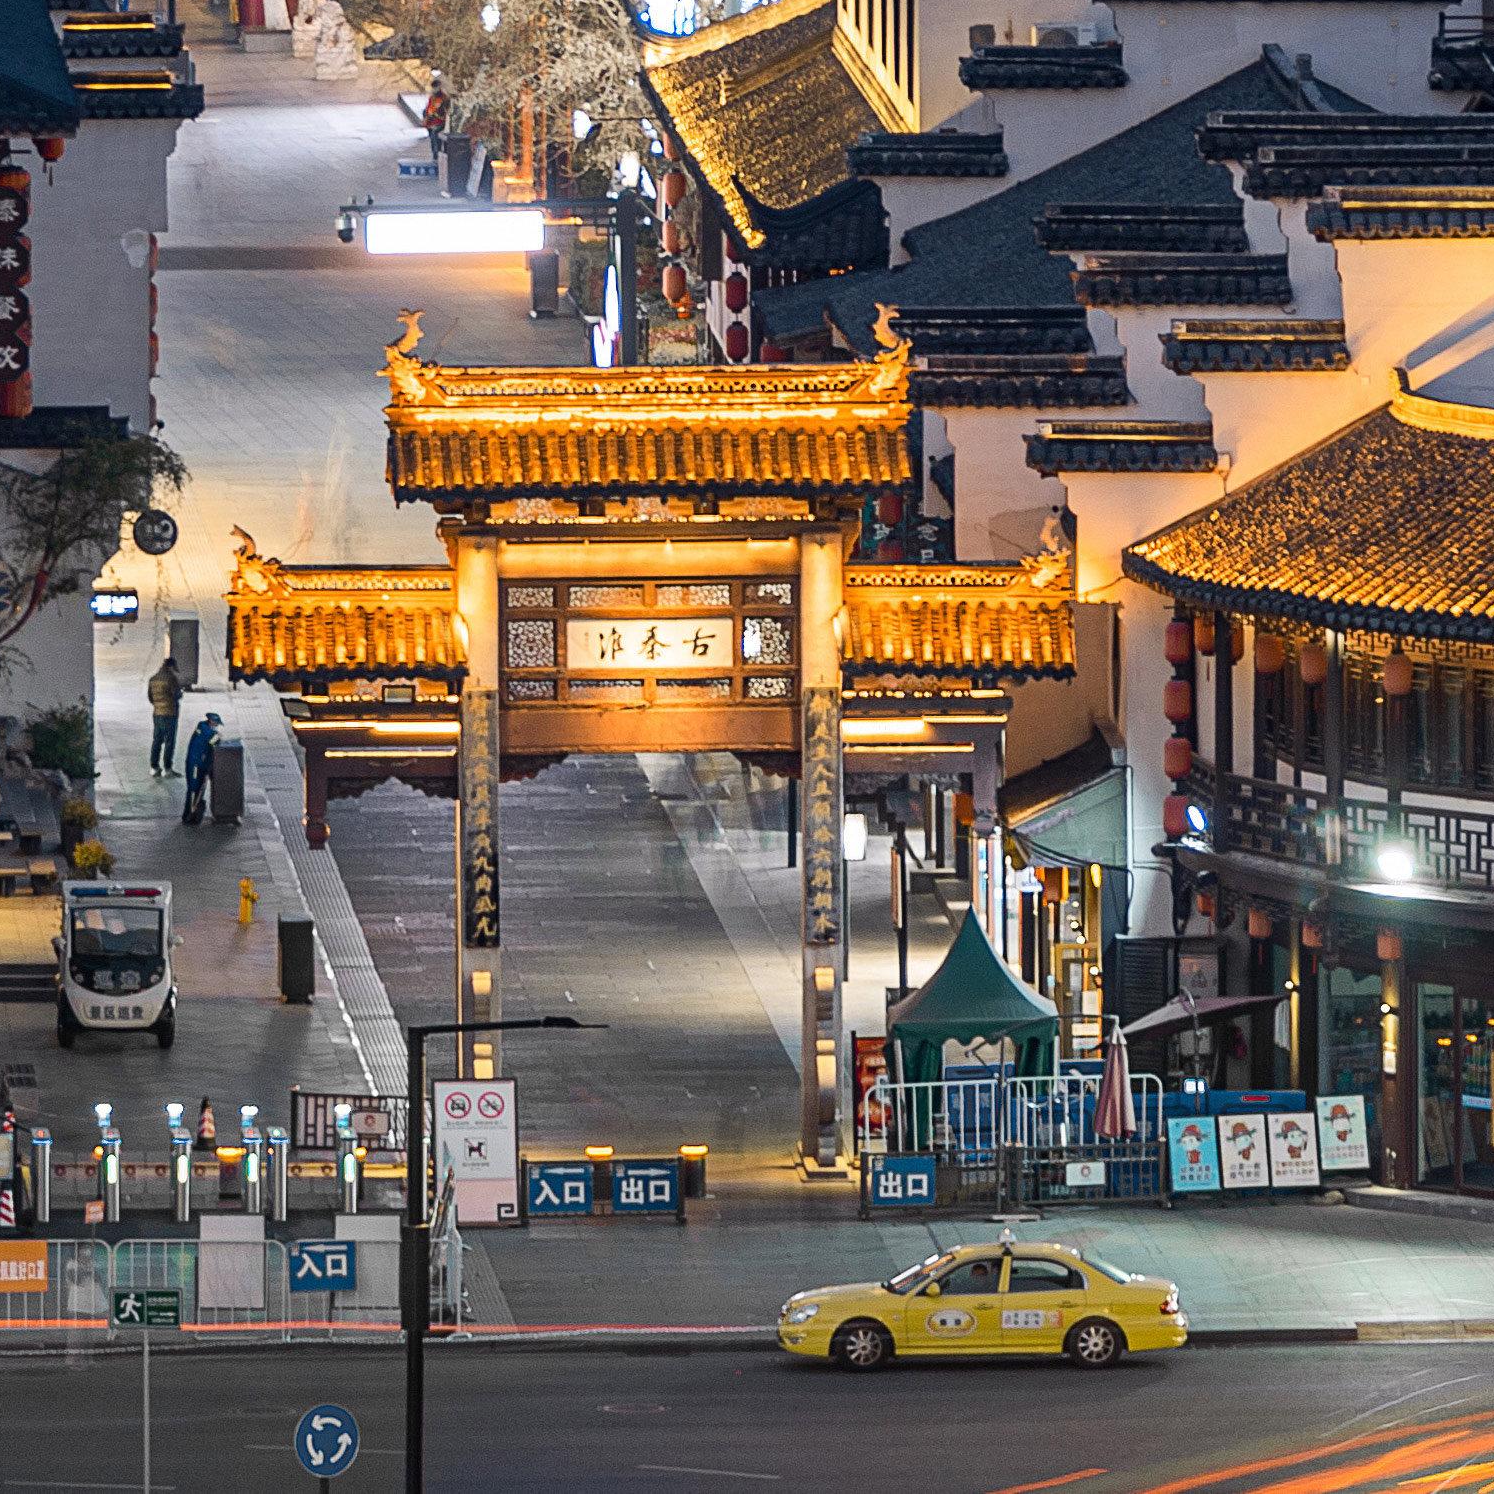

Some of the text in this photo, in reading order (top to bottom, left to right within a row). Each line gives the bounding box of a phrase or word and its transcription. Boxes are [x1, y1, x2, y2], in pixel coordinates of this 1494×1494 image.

[598, 625, 716, 660] 古秦淮
[534, 1180, 586, 1205] 入口
[620, 1177, 671, 1205] 出口
[878, 1172, 928, 1199] 出口
[296, 1253, 348, 1278] 入口
